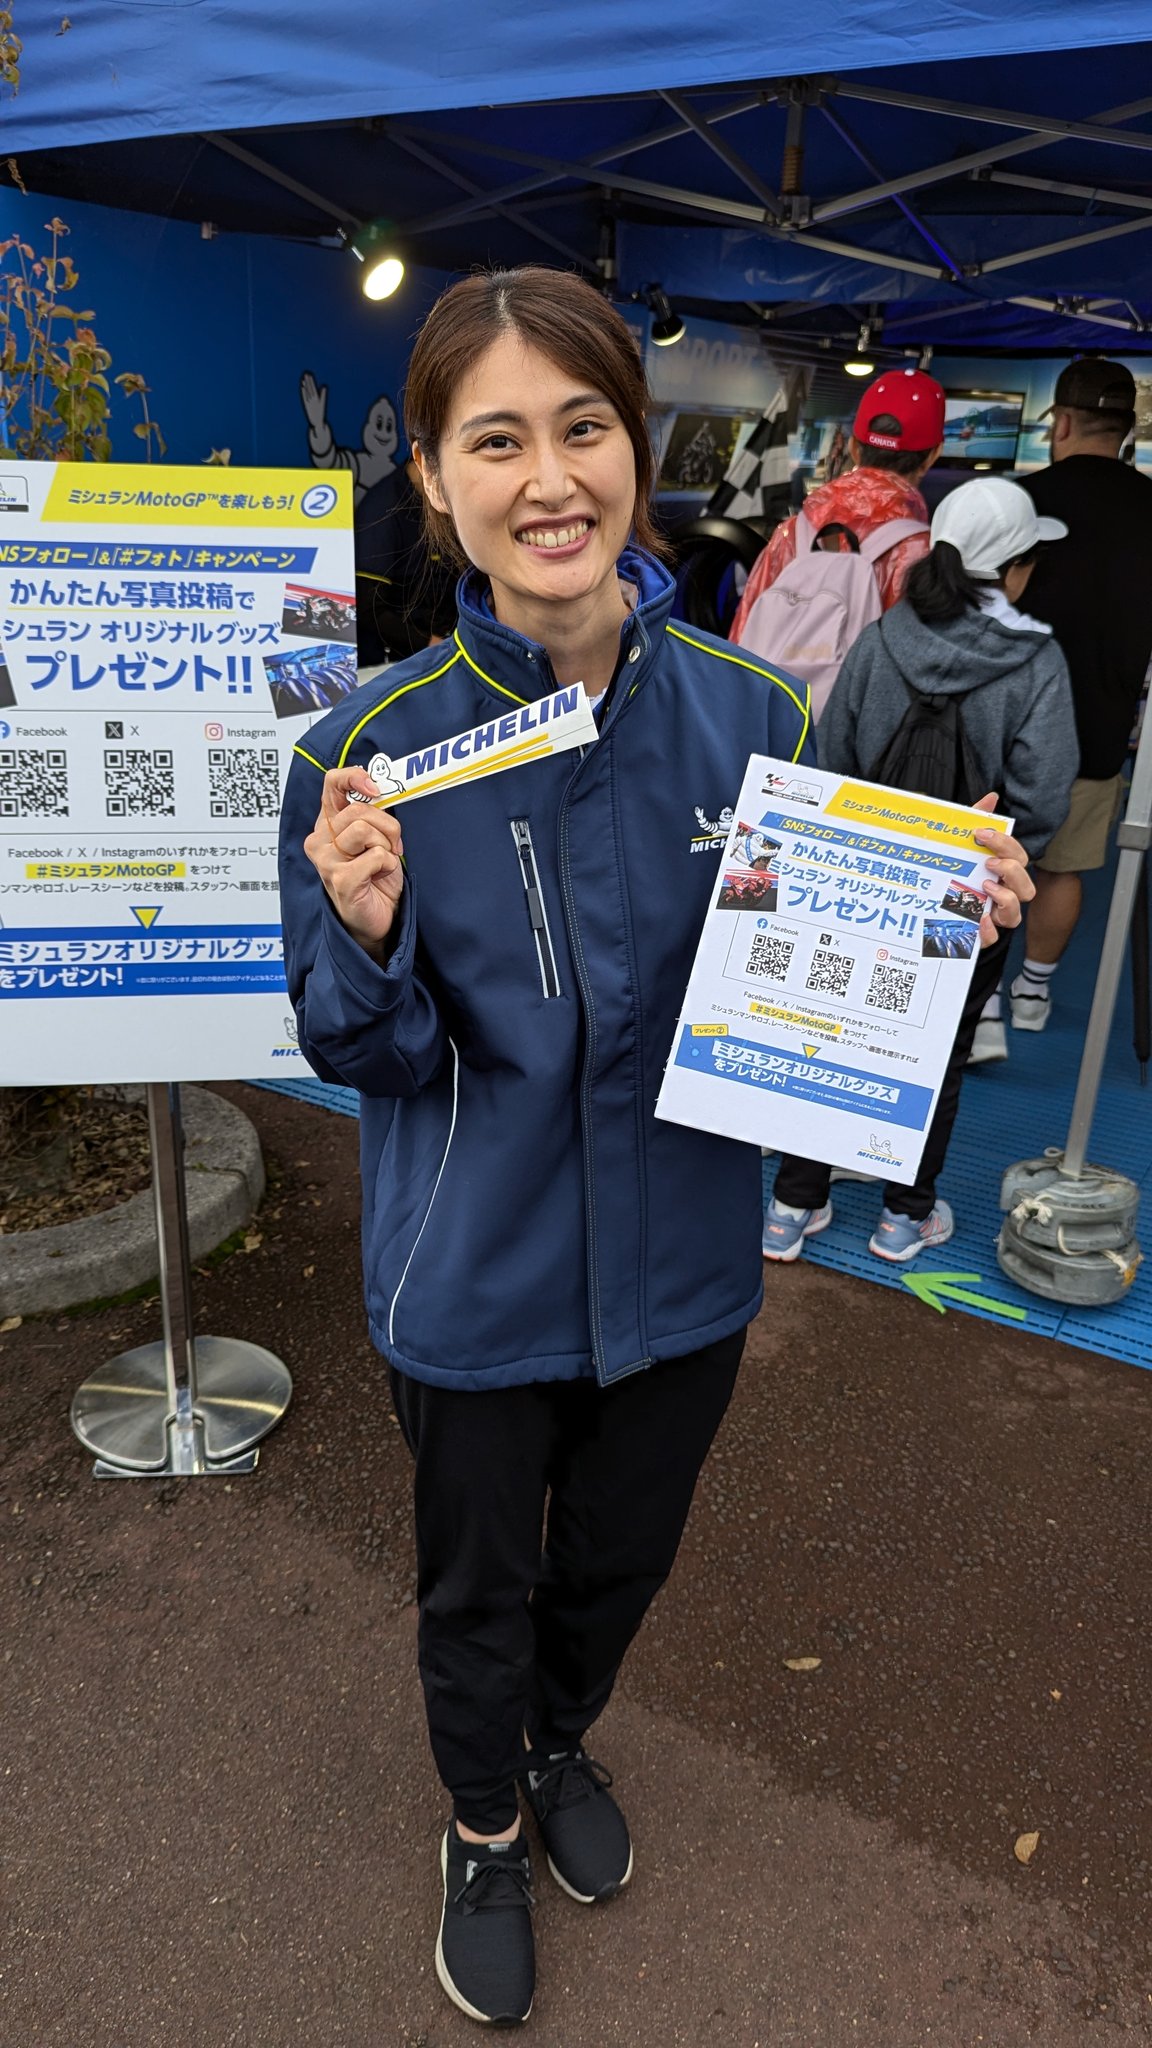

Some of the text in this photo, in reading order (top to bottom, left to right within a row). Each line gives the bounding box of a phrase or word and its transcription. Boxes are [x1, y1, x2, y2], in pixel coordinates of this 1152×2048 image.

[869, 435, 896, 449] CANADA
[10, 579, 256, 611] かんたん写真投稿で
[0, 619, 283, 645] シュラン オリジナルグッズ
[26, 651, 253, 694] プレゼント!!
[16, 727, 69, 738] Facebook
[130, 726, 140, 736] X
[227, 728, 277, 740] Instagram
[405, 686, 579, 781] MICHELIN
[8, 848, 64, 859] Facebook
[77, 848, 87, 858] X
[102, 846, 278, 859] Instagramのいずれかをフォローして
[37, 863, 232, 877] #ミシュランMotoGP をつけて
[791, 841, 931, 891] かんたん写真投稿で
[767, 859, 942, 914] ミシュラン オリジナルグッズ
[787, 885, 918, 938] プレゼント!!
[769, 924, 800, 937] Facebook
[0, 938, 284, 964] ミシュランオリジナルグッ
[833, 939, 840, 947] X
[889, 954, 919, 967] Instagram
[743, 991, 775, 1004] Facebook
[796, 1004, 900, 1037] Instagramのいずれかをフォローして
[755, 1004, 867, 1041] #ミシュランMotoGP をつけて
[271, 1048, 304, 1058] MIC
[717, 1042, 893, 1101] ミシュランオリジナルグッズ
[856, 1151, 902, 1167] MICHELIN
